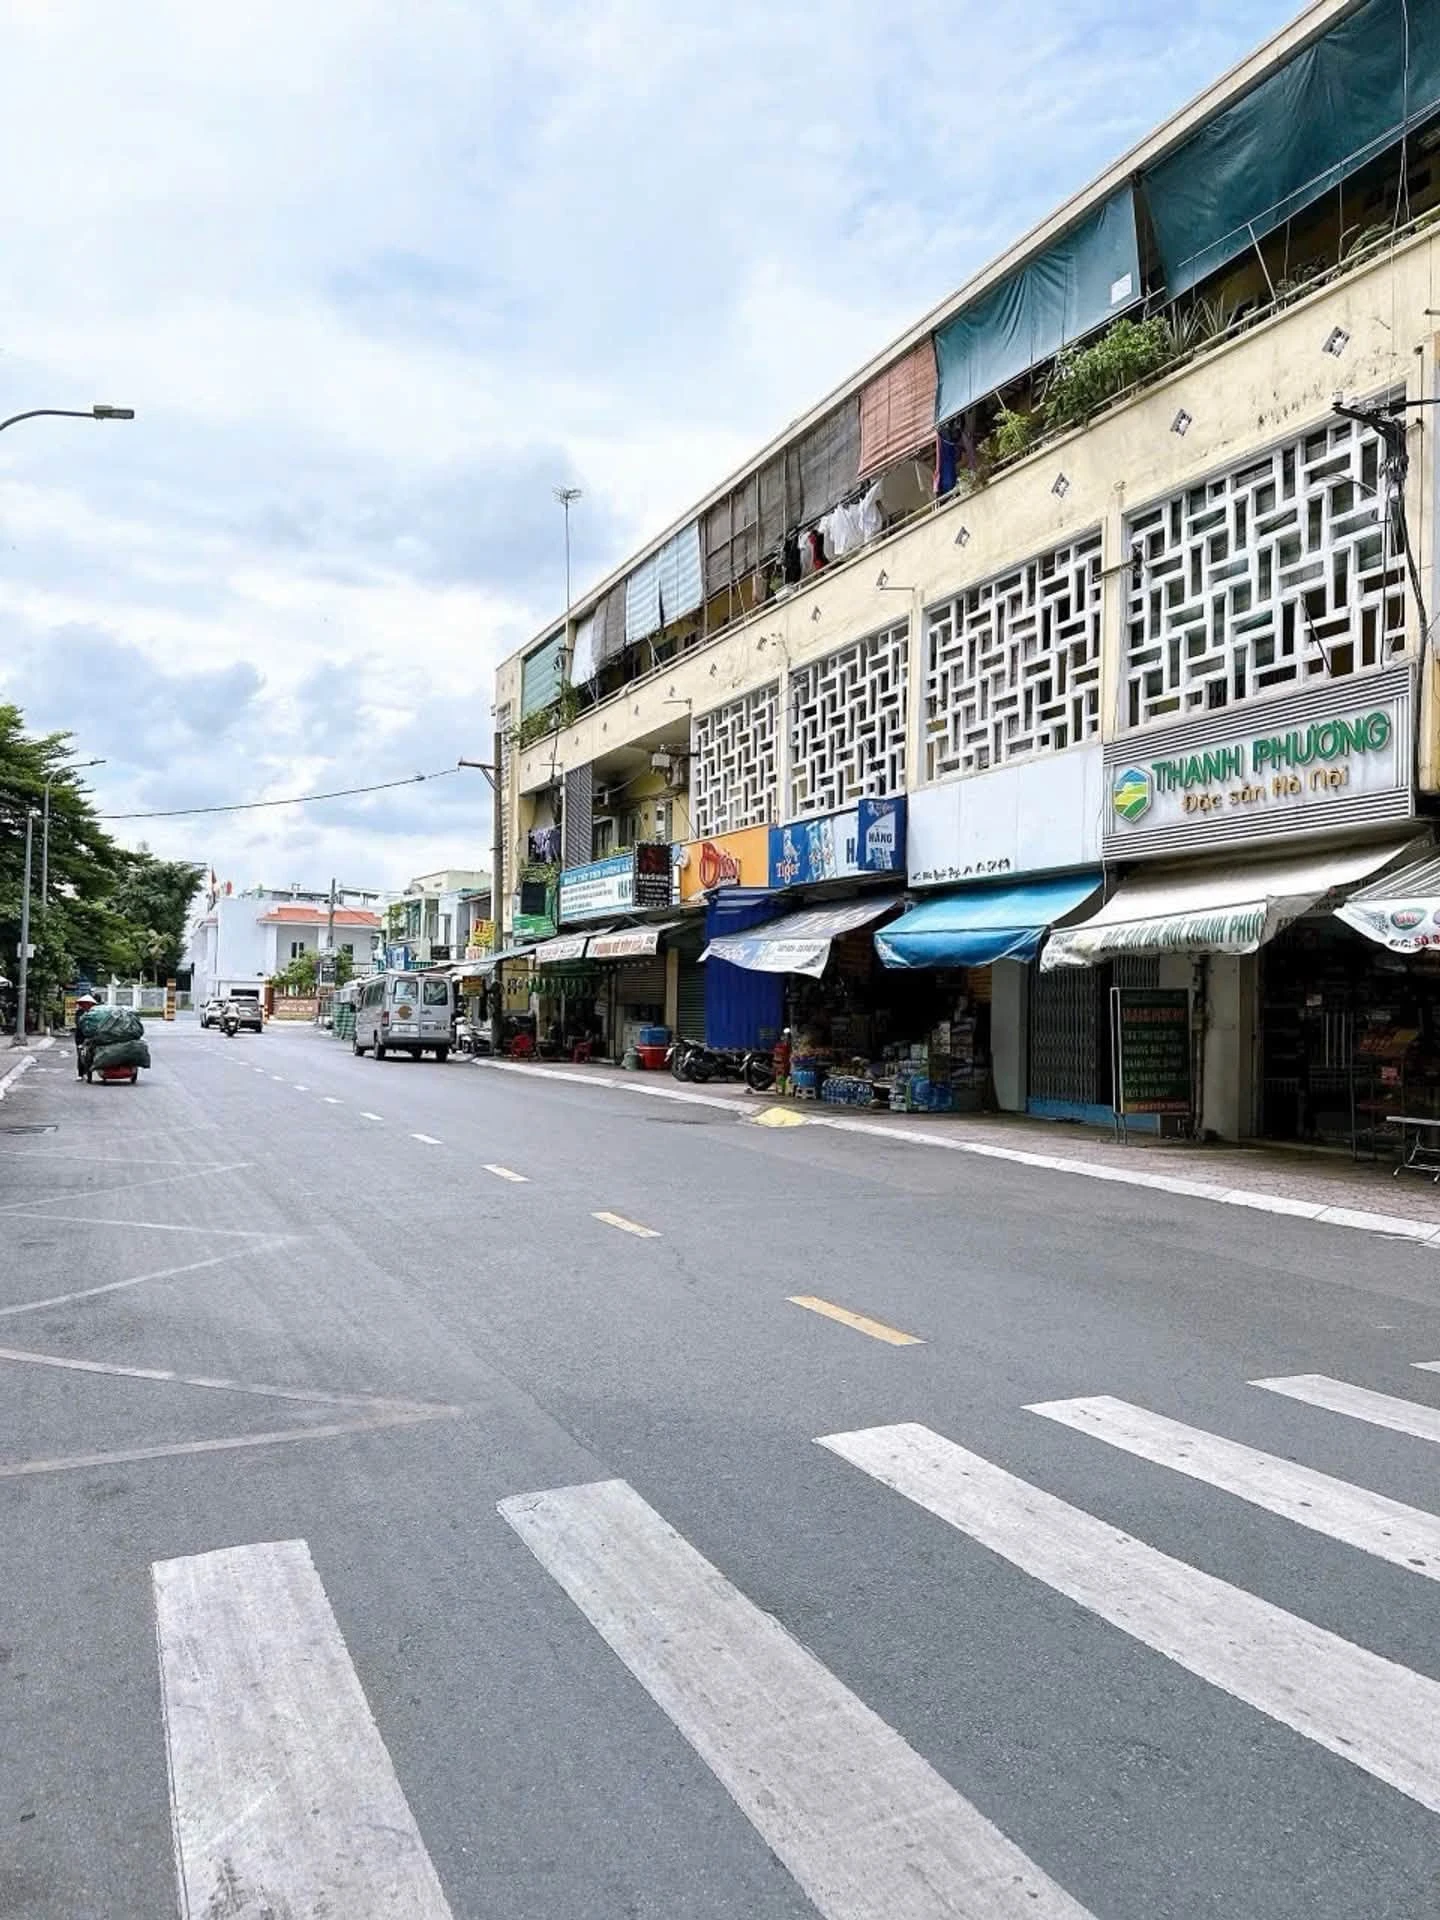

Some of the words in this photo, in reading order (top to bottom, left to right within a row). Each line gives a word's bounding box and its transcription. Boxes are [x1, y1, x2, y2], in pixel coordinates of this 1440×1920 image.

[1151, 745, 1243, 792] THANH
[1252, 712, 1391, 773] PHƯƠNG
[1183, 792, 1221, 815] Đặc
[1272, 774, 1302, 796] Hà
[1309, 764, 1349, 793] Nội
[776, 860, 800, 884] Tiger
